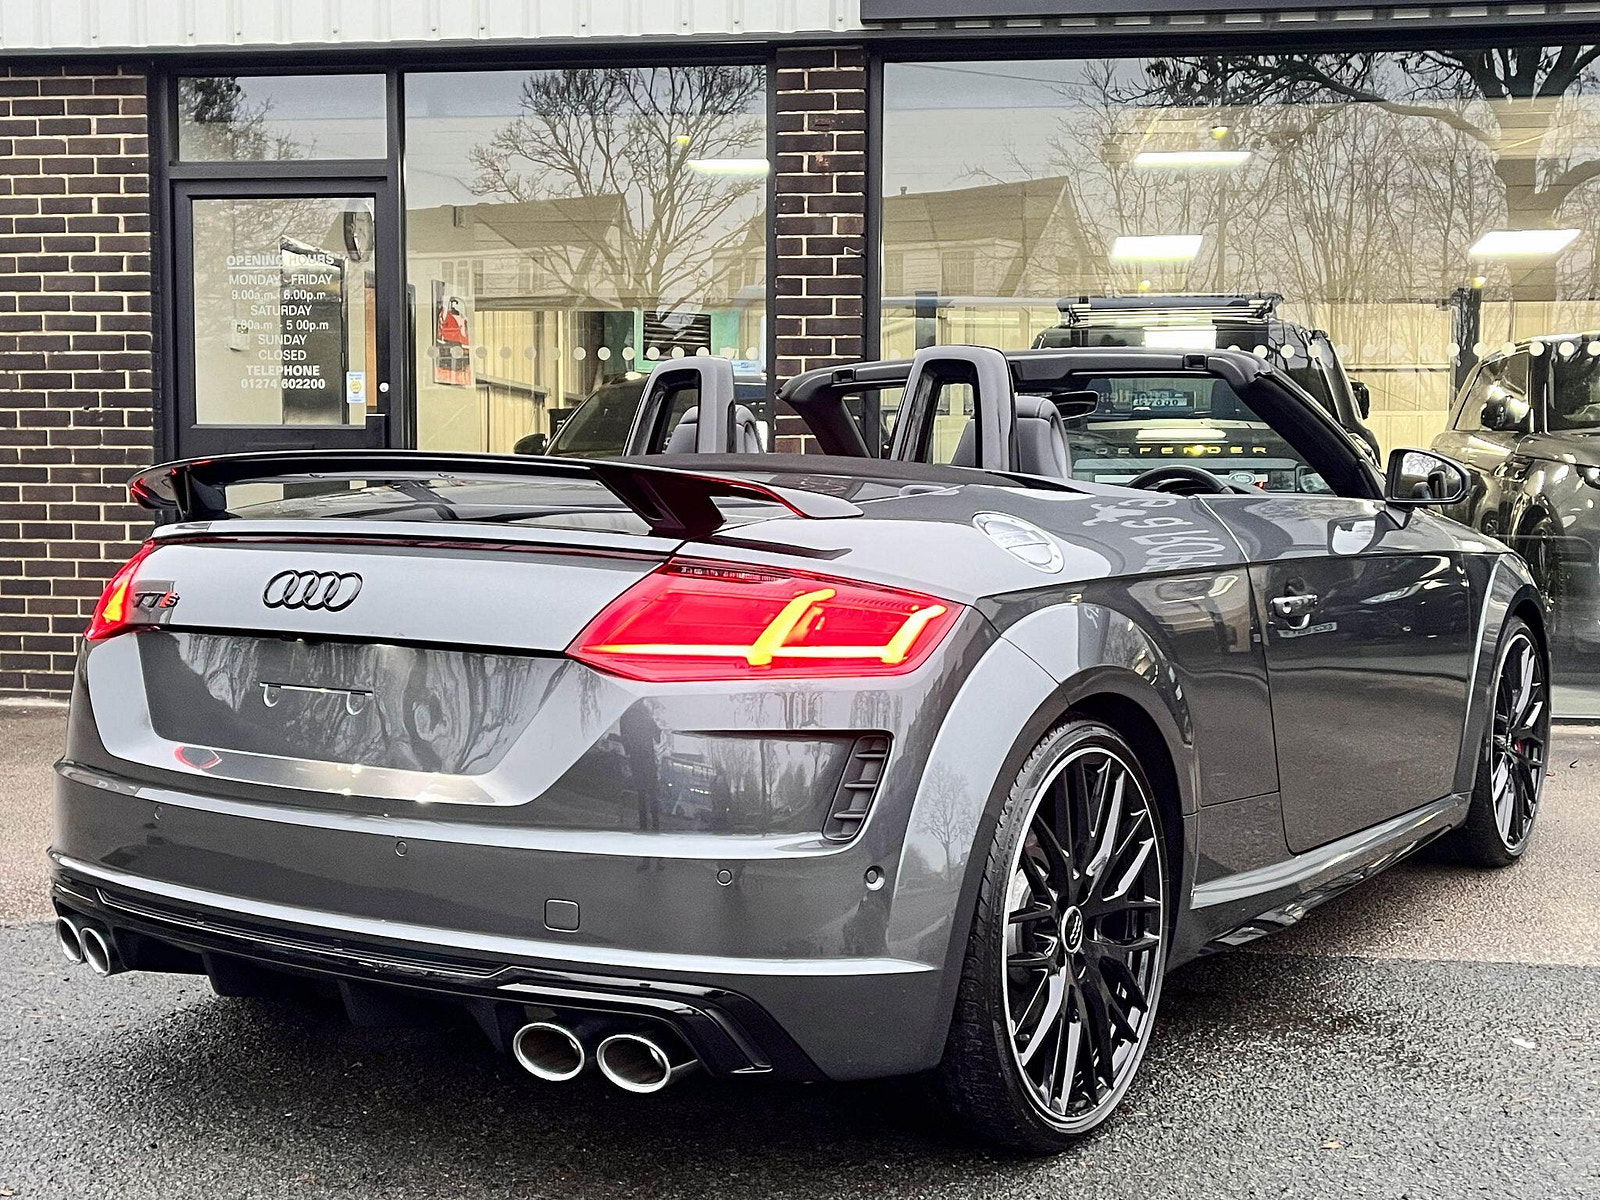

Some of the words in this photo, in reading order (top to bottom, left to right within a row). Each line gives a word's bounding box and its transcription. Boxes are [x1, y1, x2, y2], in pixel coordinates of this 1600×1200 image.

[226, 254, 281, 266] OPENING
[289, 253, 335, 266] HOURS
[229, 274, 281, 285] MONDAY
[291, 274, 333, 285] FRIDAY
[250, 304, 313, 316] SATURDAY
[258, 334, 308, 346] SUNDAY
[258, 349, 307, 361] CLOSED
[246, 365, 320, 376] TELEPHONE
[241, 378, 278, 389] 01274
[281, 378, 326, 390] 602200
[1095, 445, 1268, 455] DEFENDER
